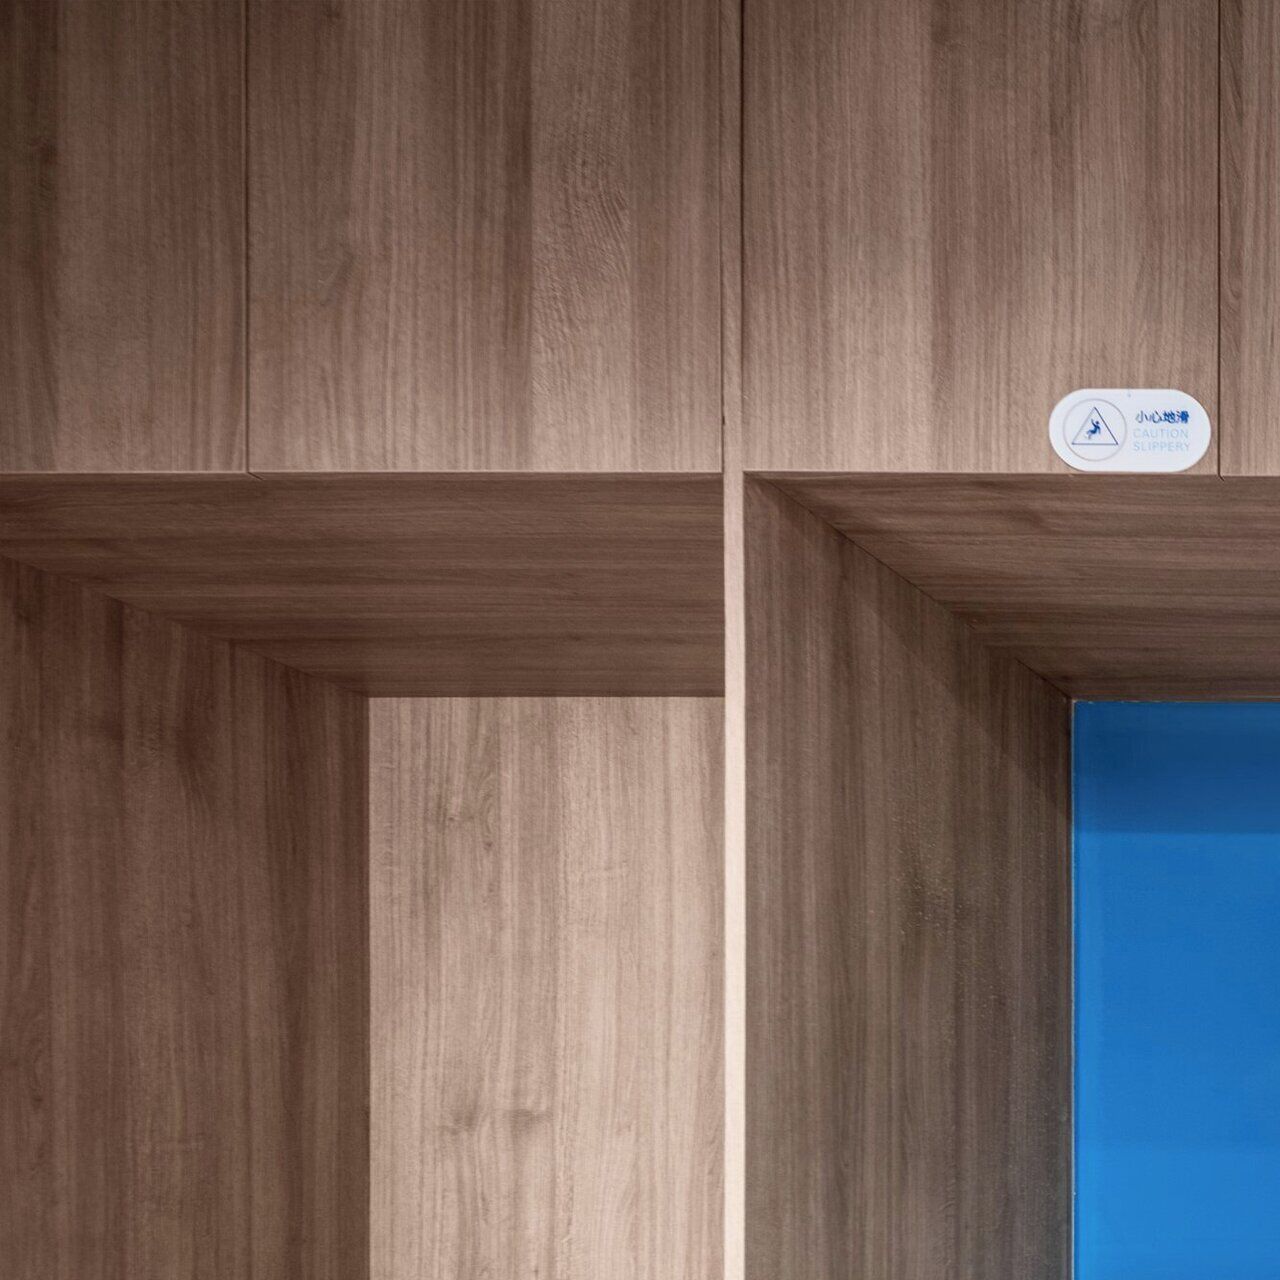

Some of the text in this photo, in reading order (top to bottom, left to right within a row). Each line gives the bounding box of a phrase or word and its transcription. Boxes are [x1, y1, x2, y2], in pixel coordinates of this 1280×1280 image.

[1135, 410, 1190, 424] 小心地滑
[1133, 429, 1188, 439] CAUTION
[1133, 442, 1190, 452] SLIPPERY
